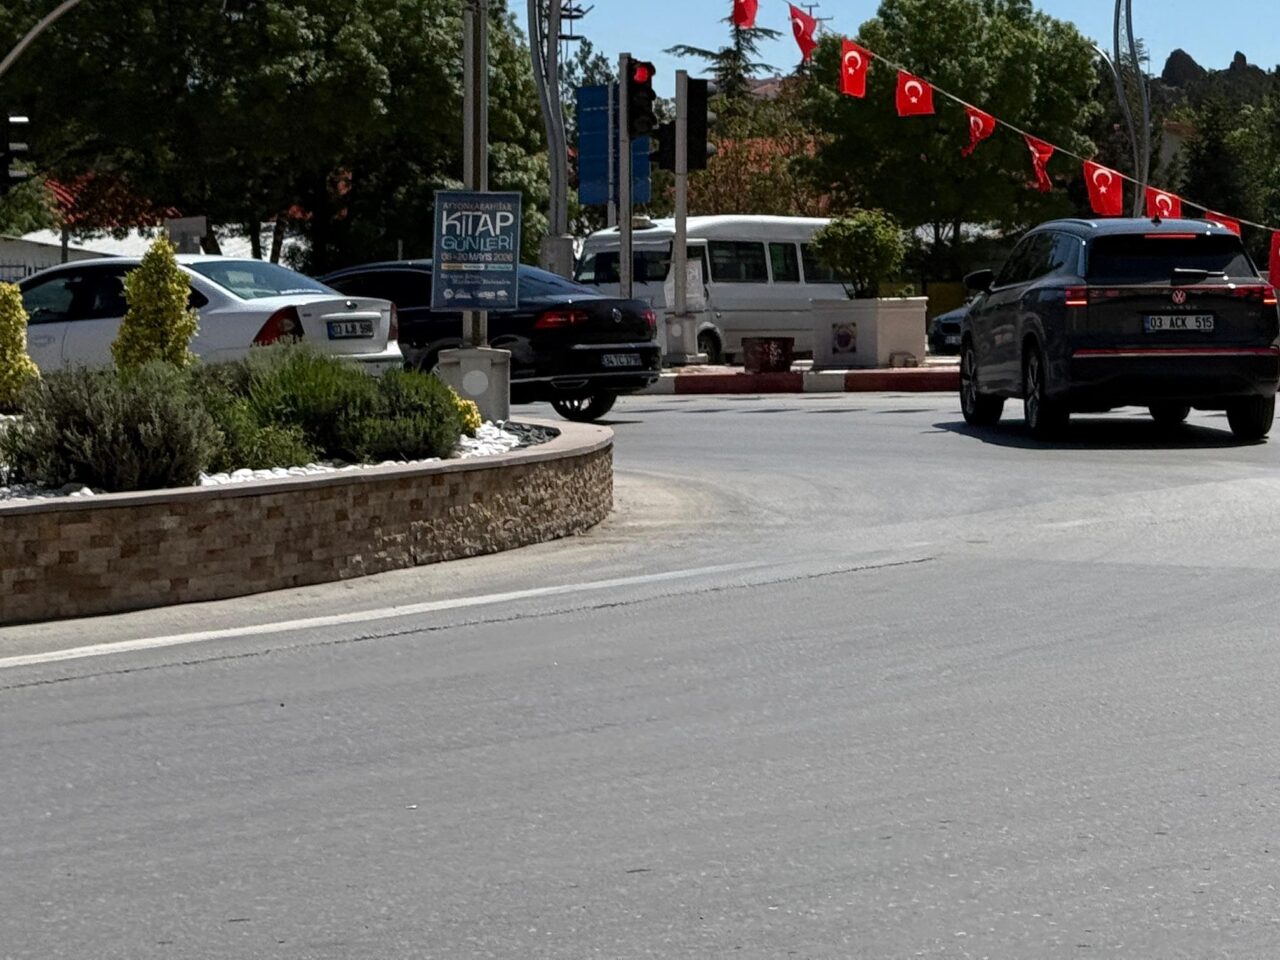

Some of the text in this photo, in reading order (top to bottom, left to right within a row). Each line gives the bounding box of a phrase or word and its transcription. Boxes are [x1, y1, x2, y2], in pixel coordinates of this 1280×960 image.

[441, 232, 514, 252] GÜNLERİ
[469, 252, 493, 262] MAYIS
[1150, 316, 1213, 329] 03 ACK 515
